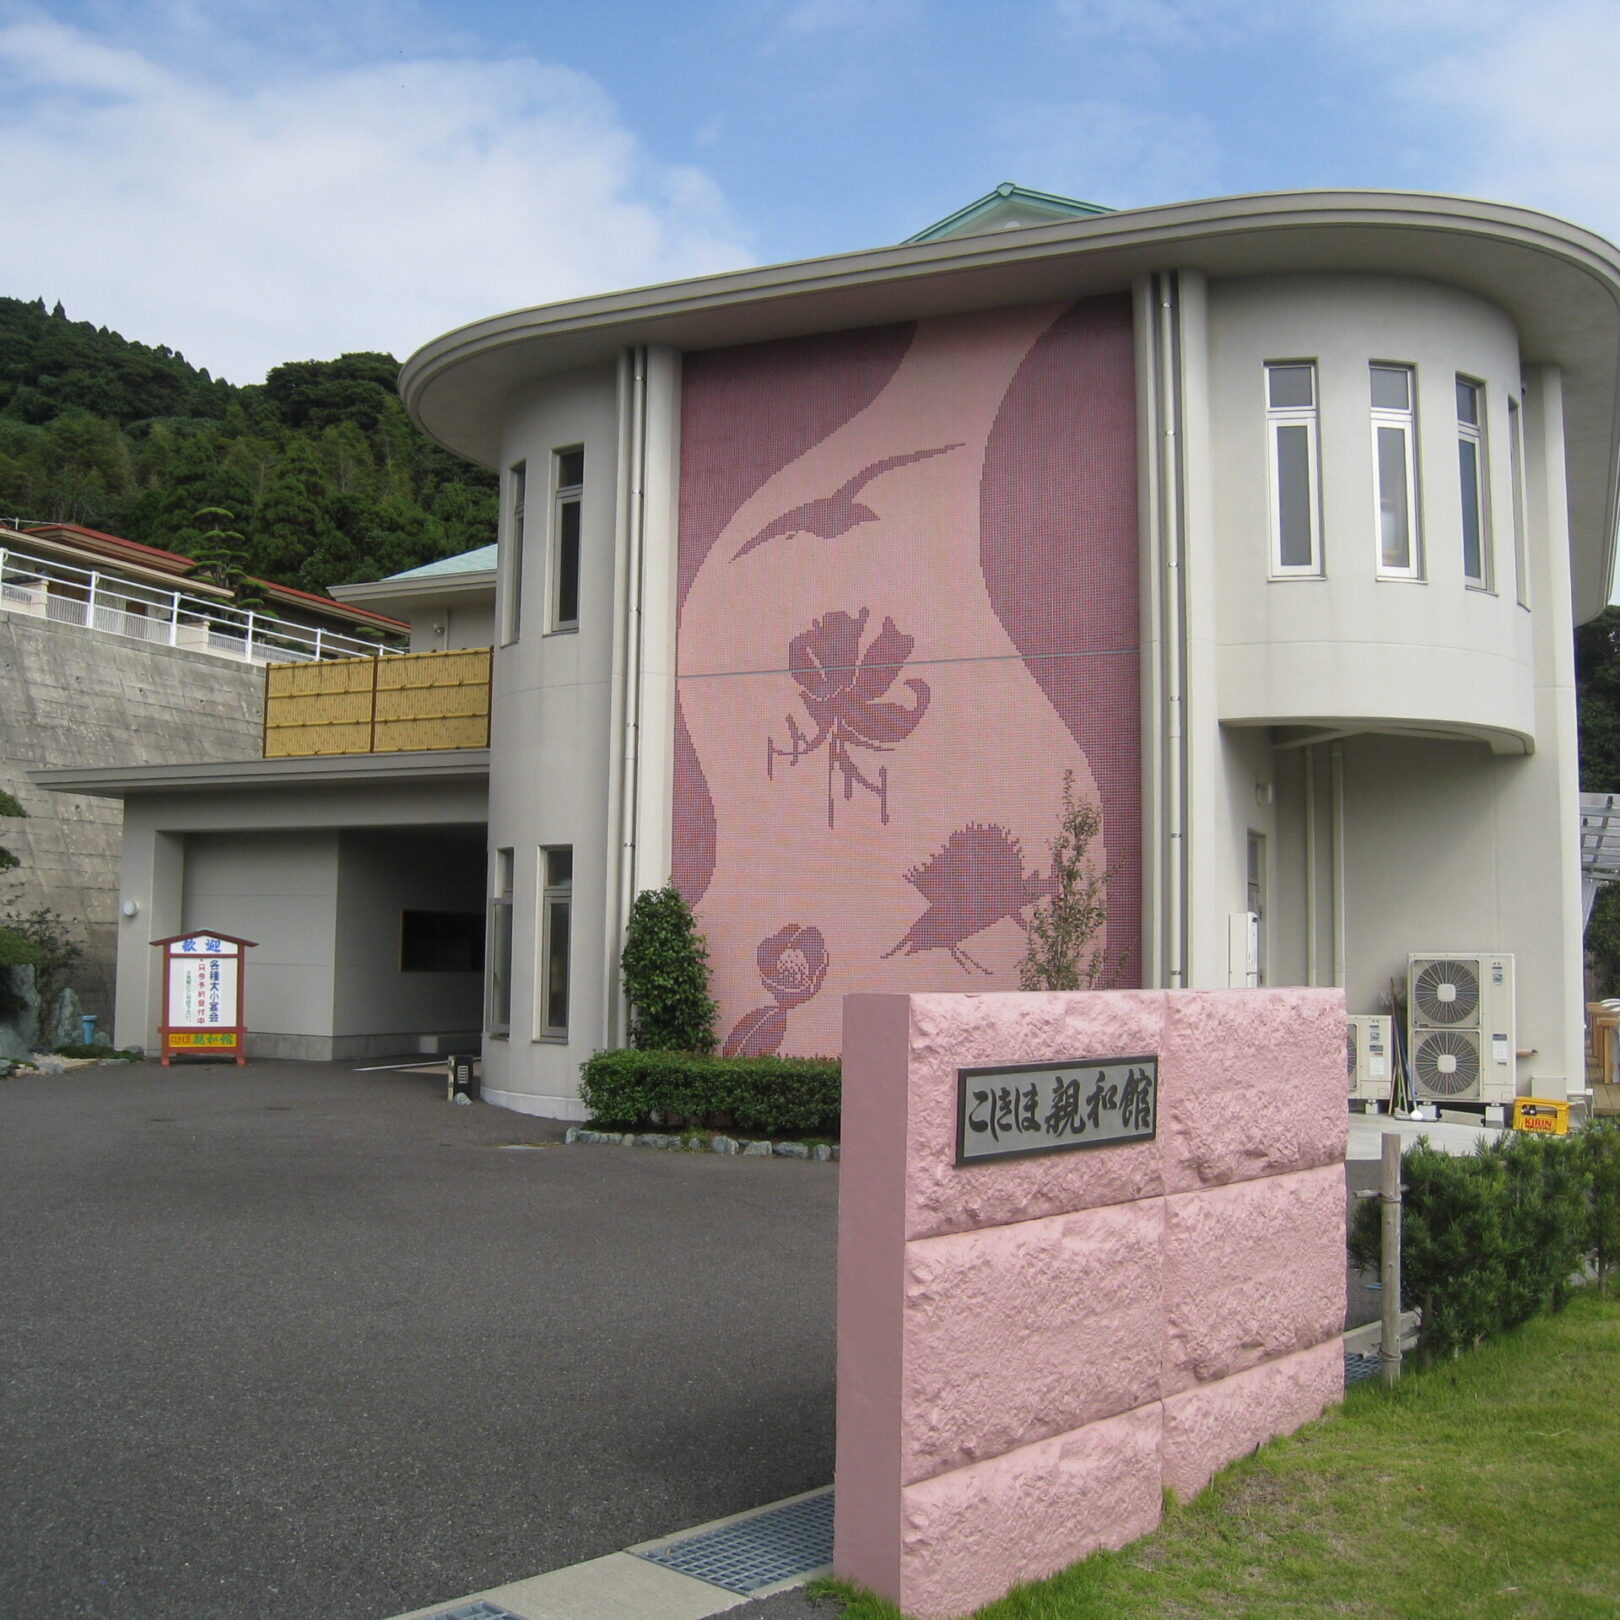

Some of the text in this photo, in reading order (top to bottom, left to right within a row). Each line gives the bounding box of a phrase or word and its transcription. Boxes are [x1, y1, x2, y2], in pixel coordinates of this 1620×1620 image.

[182, 939, 222, 952] 歓迎
[208, 960, 219, 1022] 各種大小宴会
[1524, 1117, 1552, 1129] KIRIN
